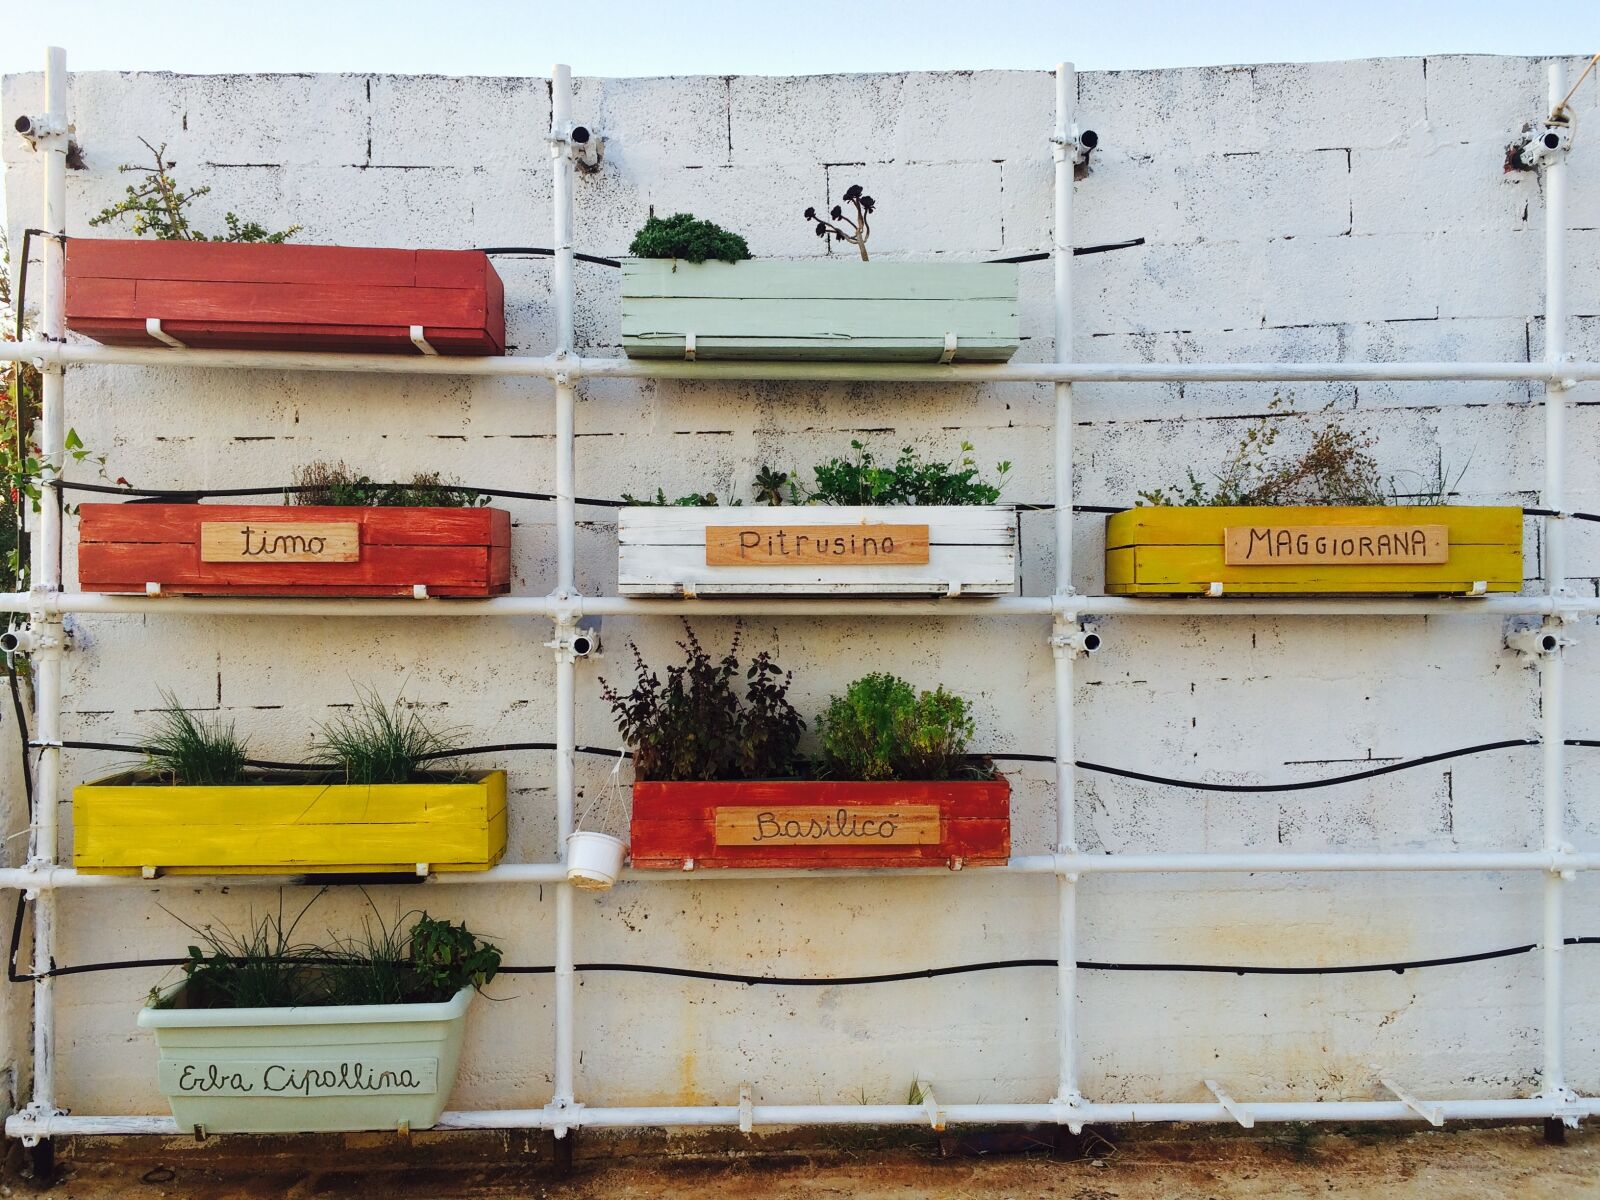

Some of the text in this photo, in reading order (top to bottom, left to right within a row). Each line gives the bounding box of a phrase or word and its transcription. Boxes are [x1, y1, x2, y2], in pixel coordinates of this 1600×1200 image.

[240, 526, 327, 556] timo
[738, 529, 895, 559] Pitrusino
[1245, 528, 1427, 559] MAGGIORANA
[179, 1062, 421, 1096] Erba Cipollina
